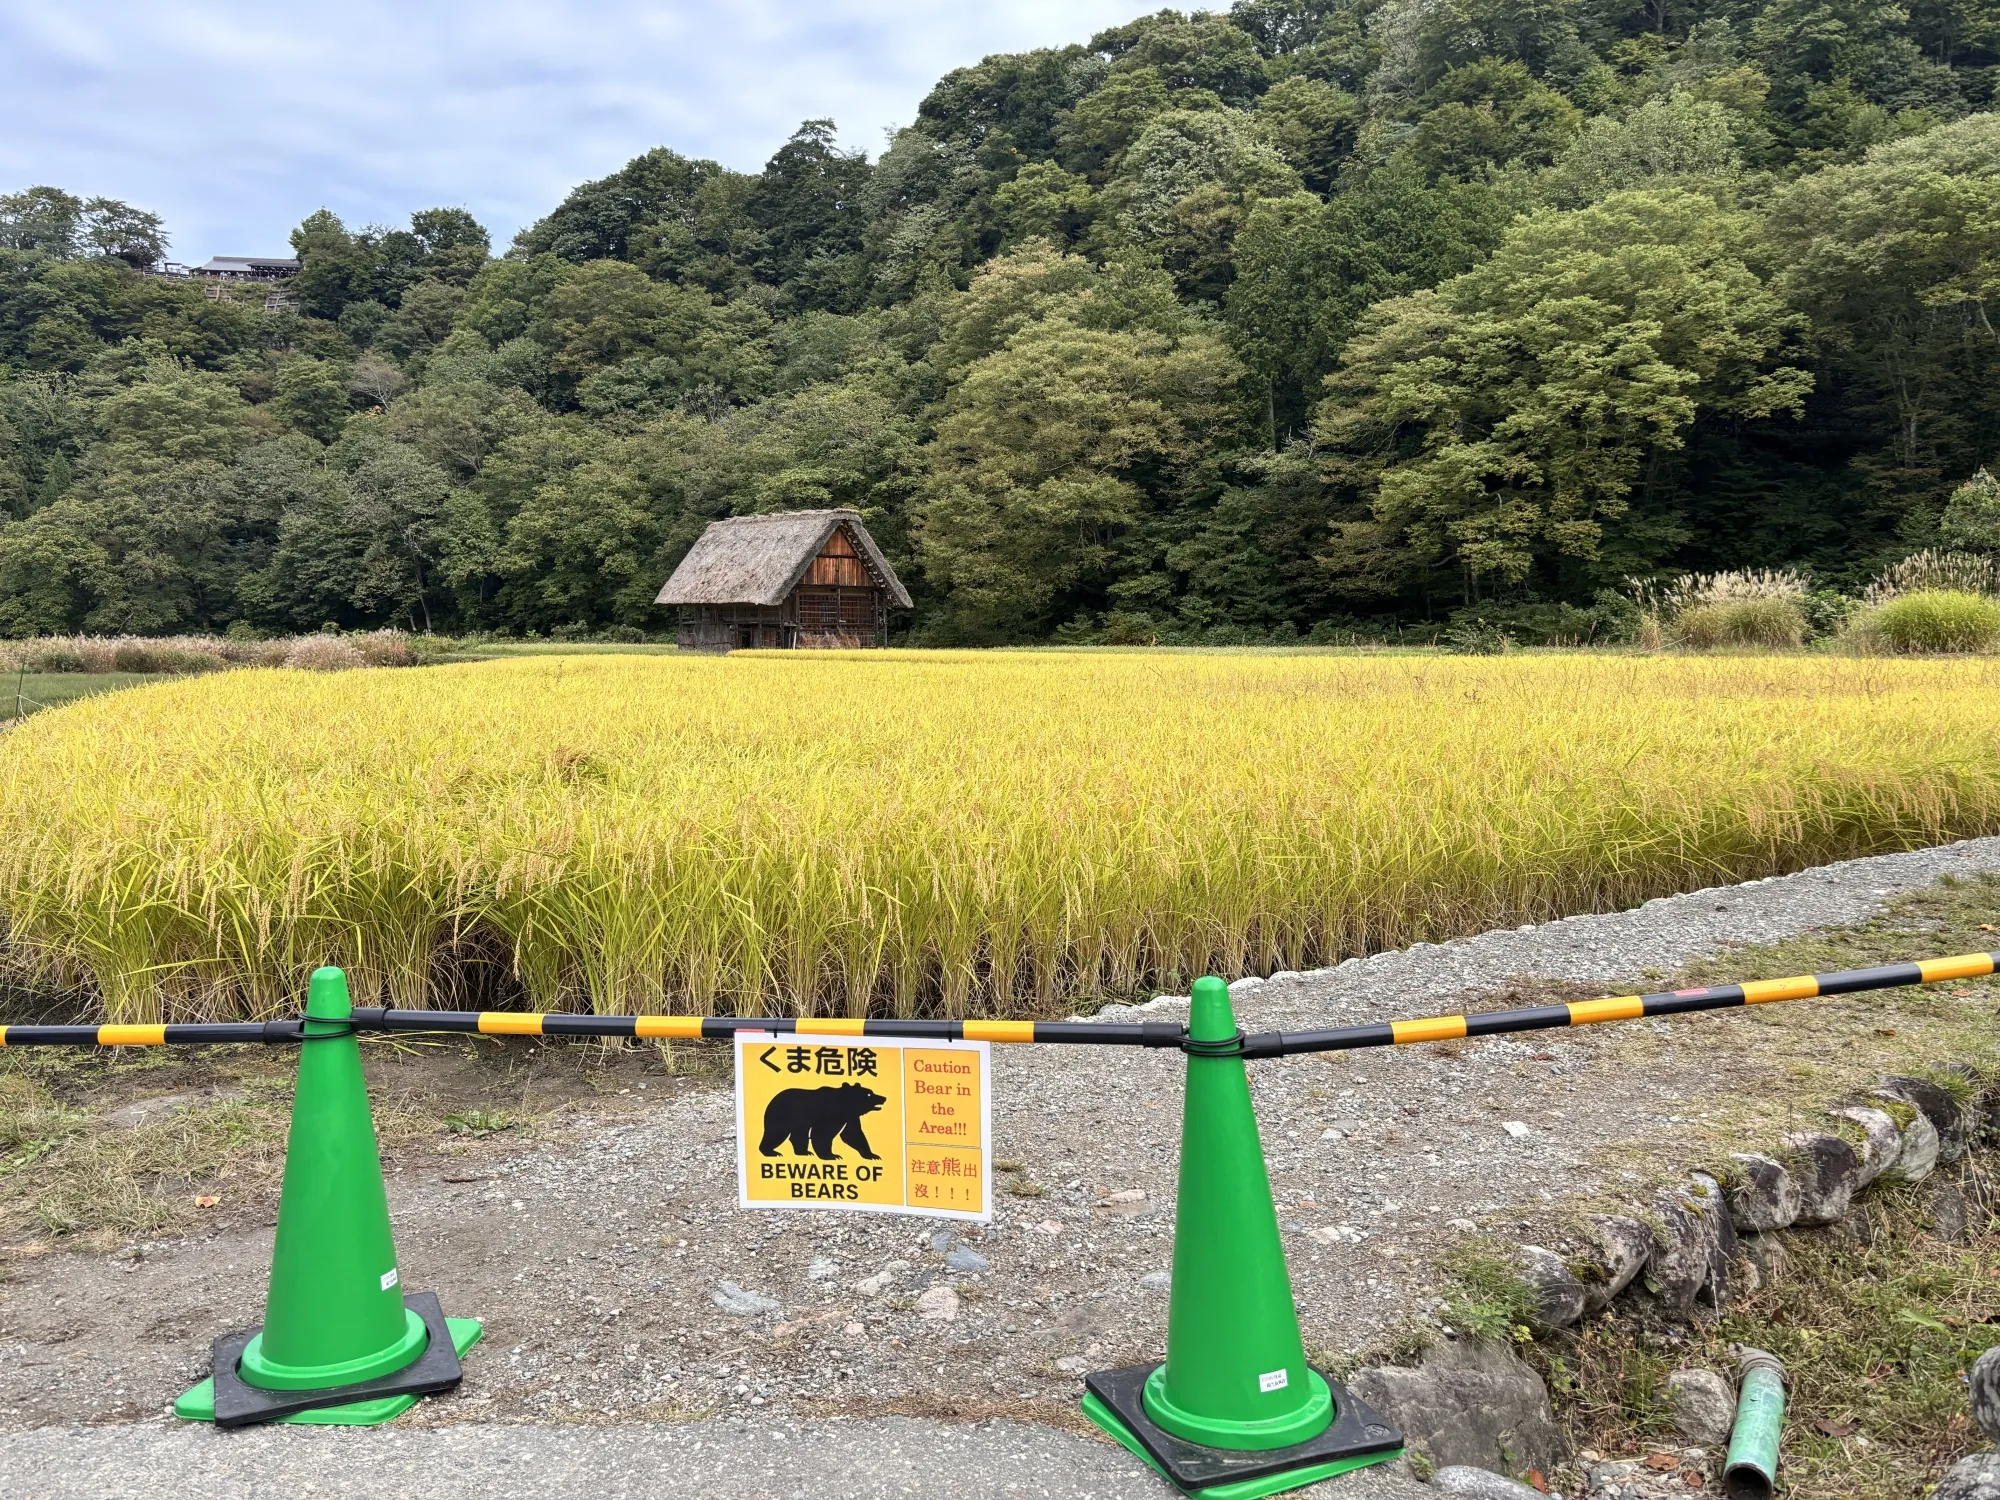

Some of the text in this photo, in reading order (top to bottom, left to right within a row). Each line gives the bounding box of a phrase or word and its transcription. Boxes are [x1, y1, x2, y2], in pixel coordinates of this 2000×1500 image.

[759, 1046, 878, 1077] くま危険
[913, 1059, 971, 1075] Caution
[914, 1080, 971, 1097] Bear in
[931, 1102, 954, 1116] the
[918, 1121, 967, 1136] Area!!!
[761, 1163, 883, 1182] BEWARE OF
[911, 1156, 977, 1179] 注意熊出
[791, 1183, 858, 1200] BEARS
